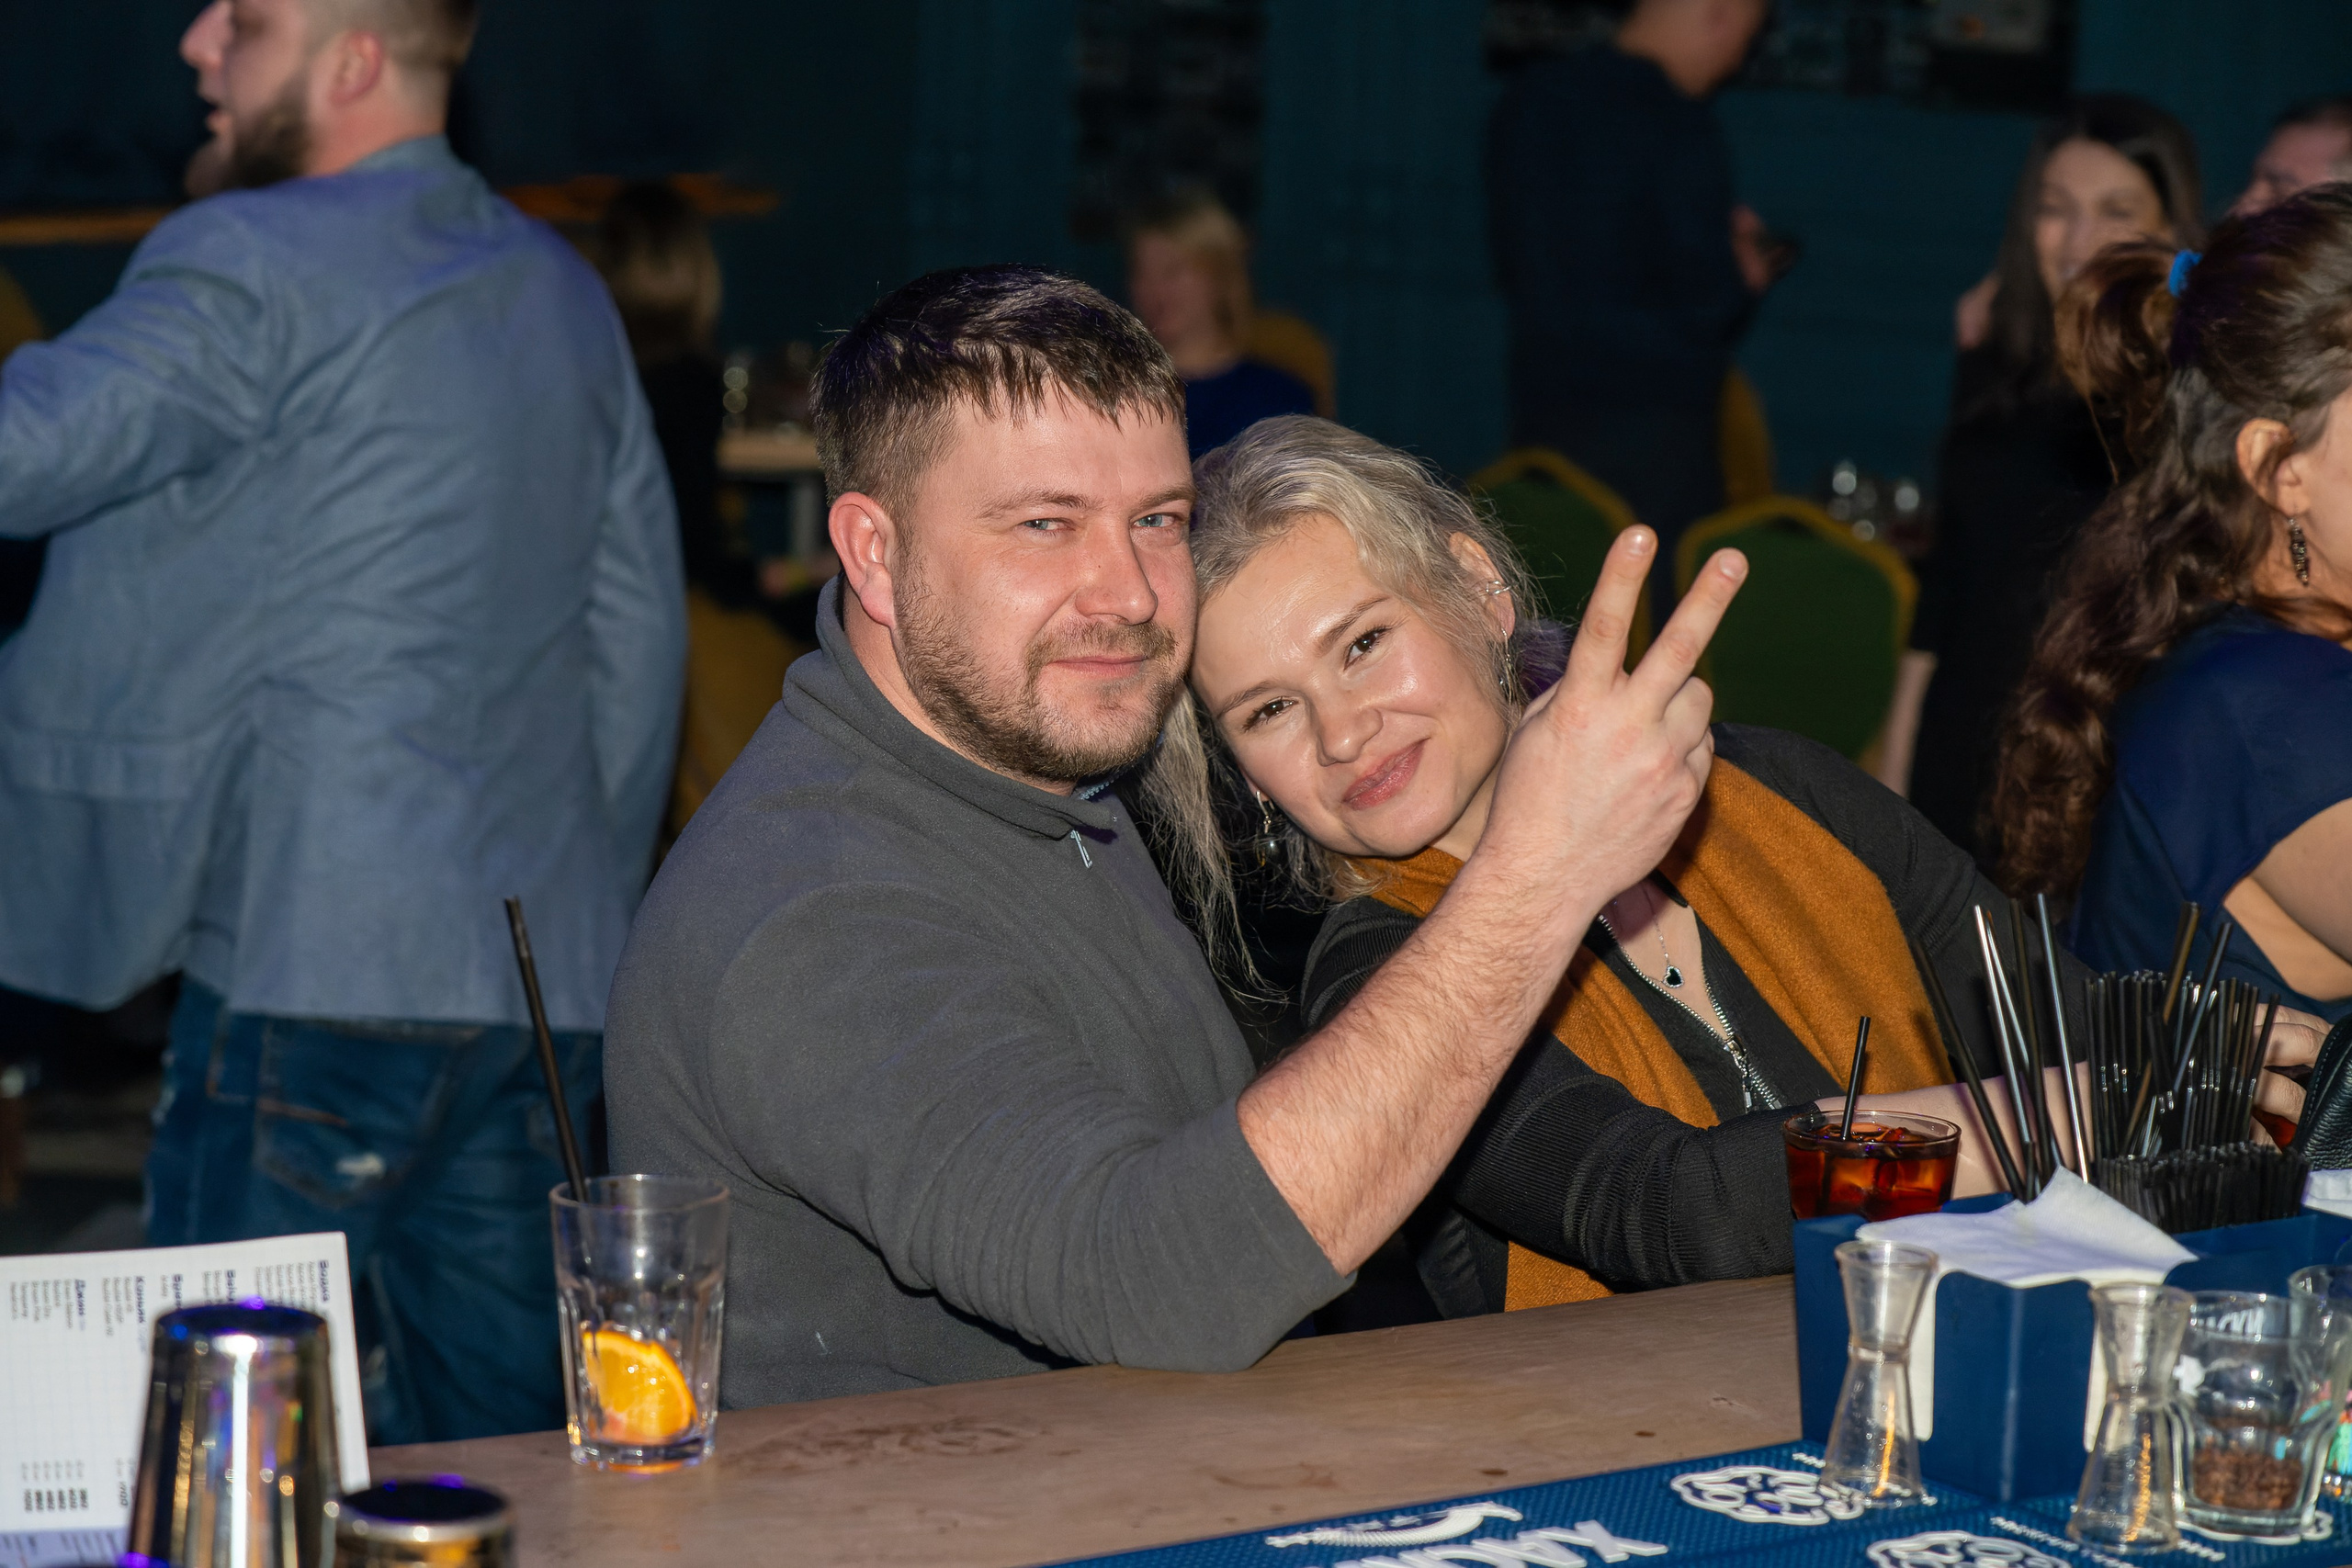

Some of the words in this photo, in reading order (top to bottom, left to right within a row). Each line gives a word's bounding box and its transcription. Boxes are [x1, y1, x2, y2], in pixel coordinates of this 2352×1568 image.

[75, 1279, 86, 1316] Джин
[135, 1275, 145, 1324] Коньяк
[319, 1259, 330, 1303] Водка
